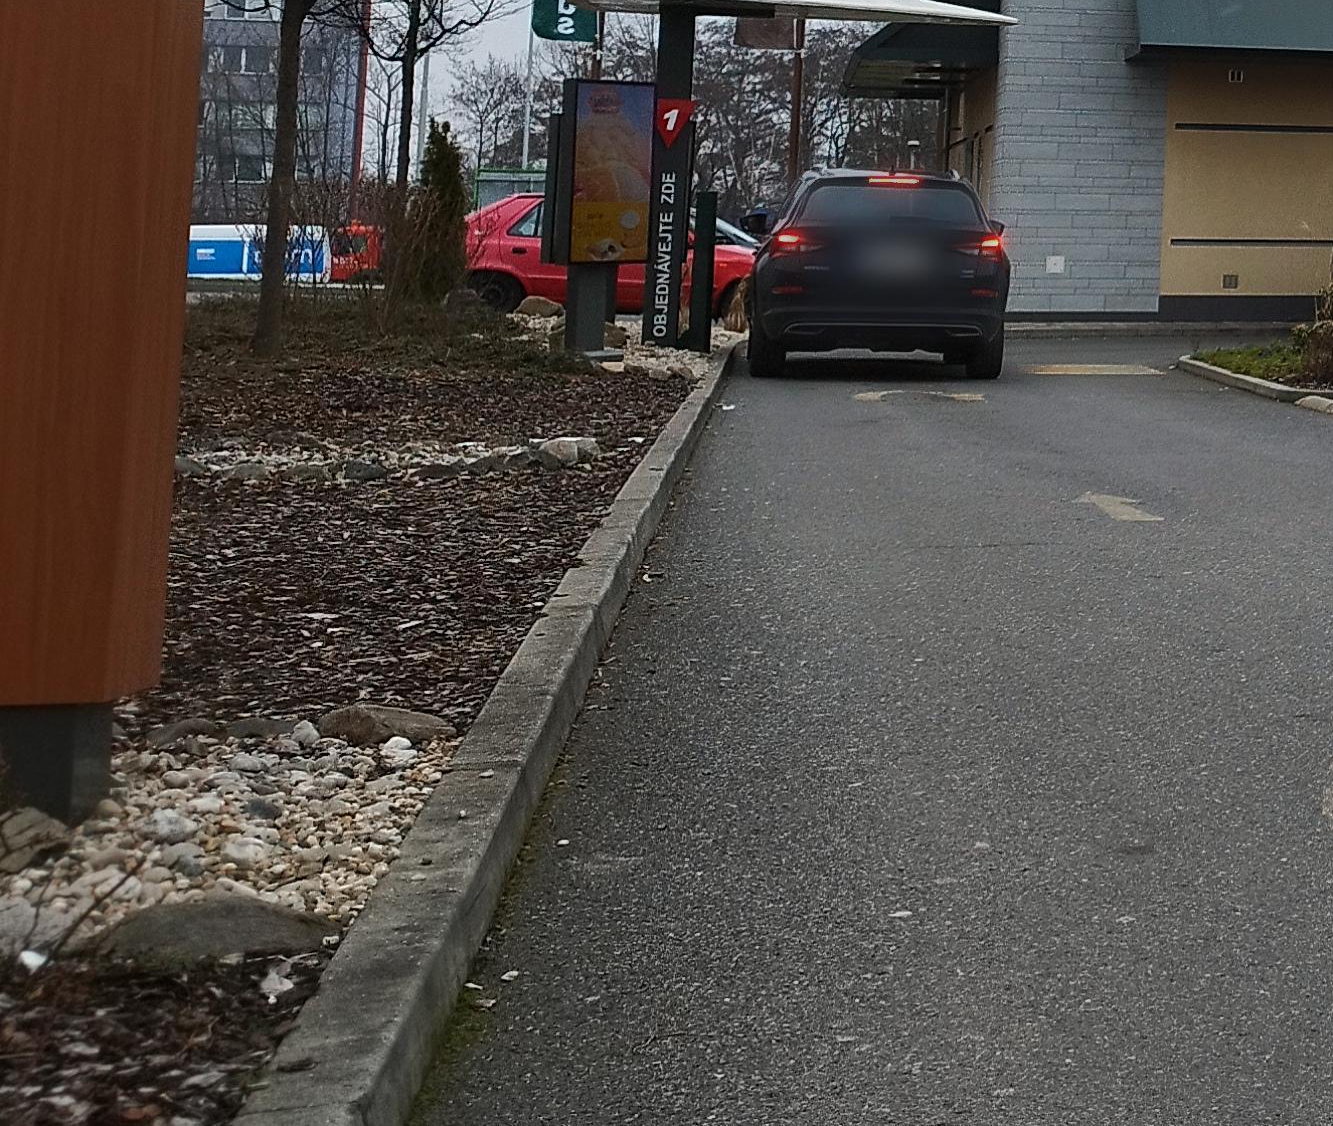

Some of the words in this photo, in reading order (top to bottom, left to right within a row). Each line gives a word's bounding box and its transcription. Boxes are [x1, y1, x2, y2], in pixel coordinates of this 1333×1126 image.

[662, 109, 679, 131] 1
[660, 171, 676, 204] ZDE
[652, 211, 674, 337] OBJEDNÁVEJTE
